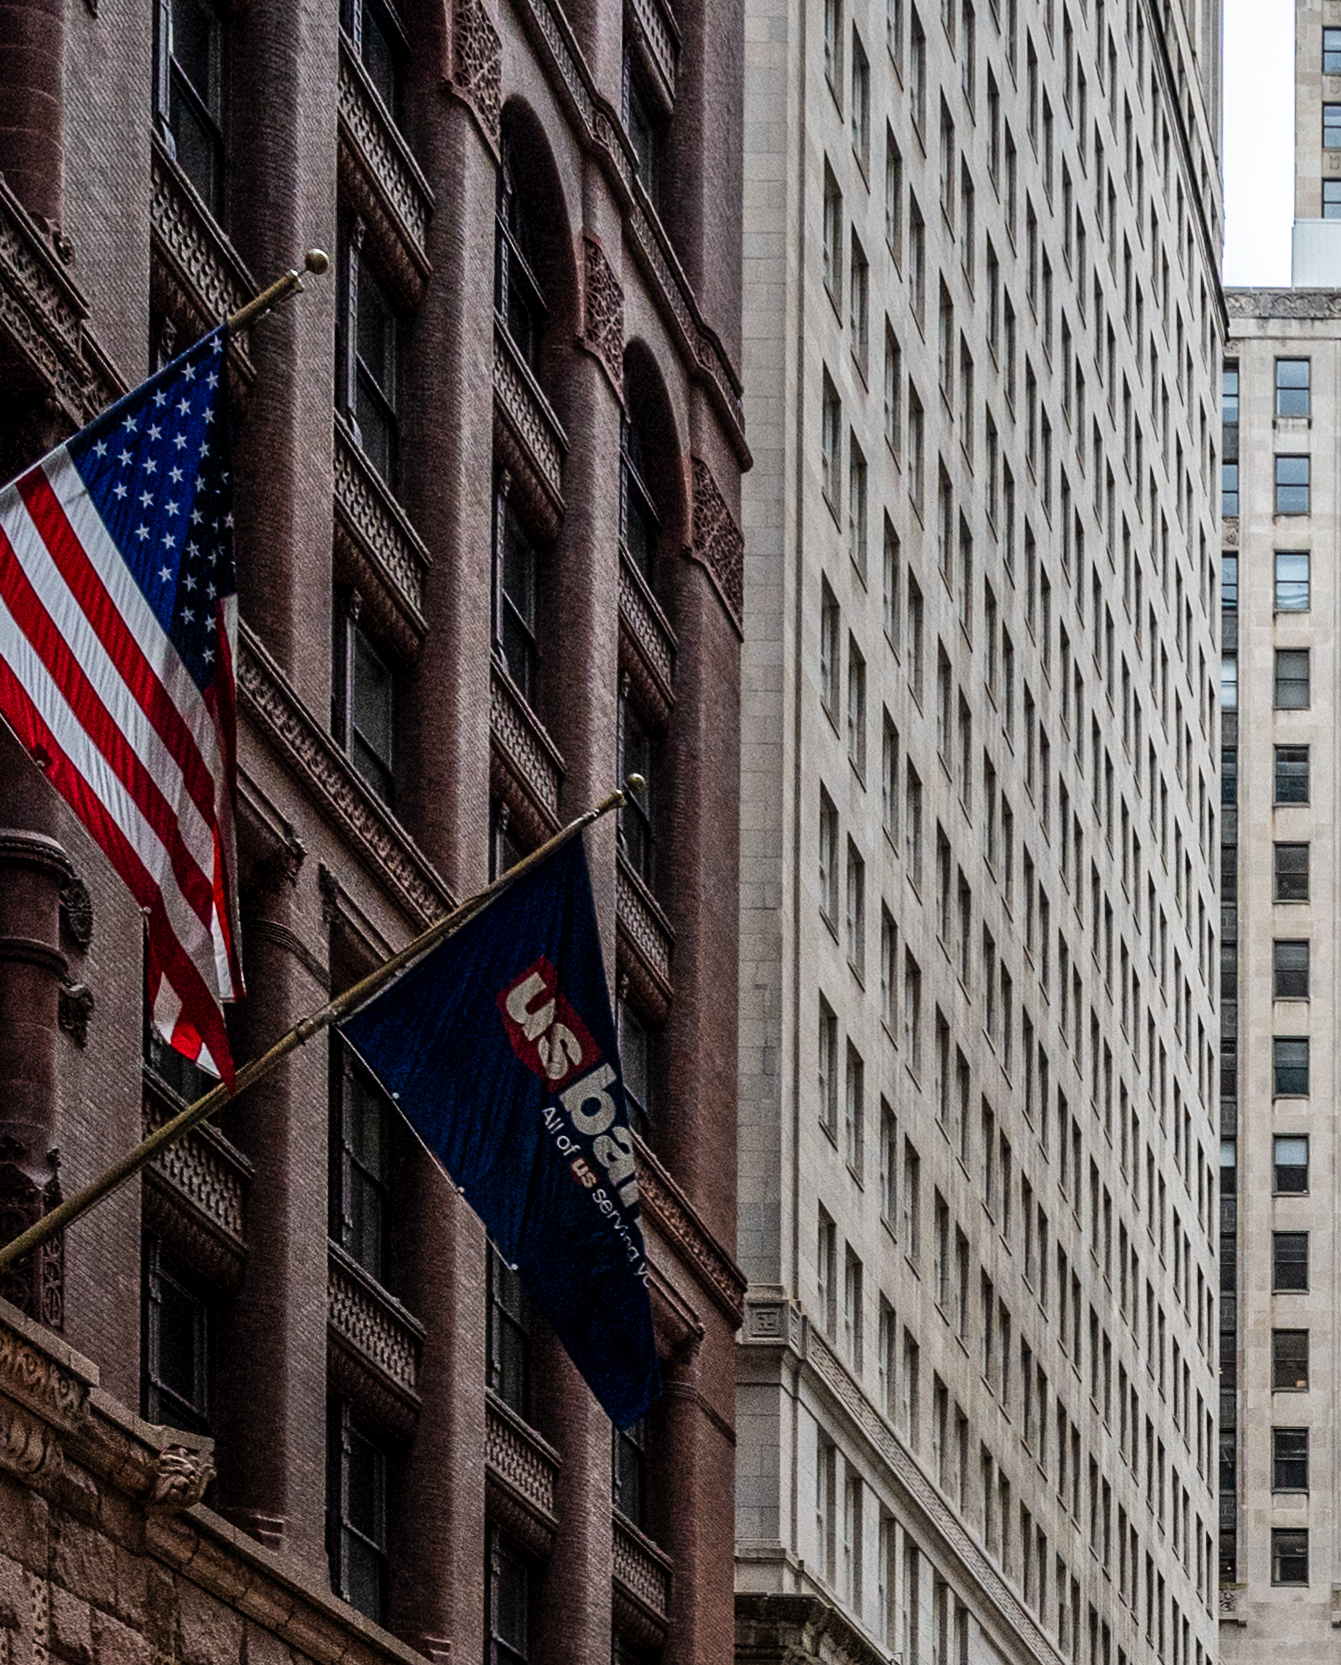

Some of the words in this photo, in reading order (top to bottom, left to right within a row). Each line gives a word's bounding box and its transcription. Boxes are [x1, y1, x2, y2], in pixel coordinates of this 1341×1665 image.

[542, 1106, 565, 1135] All
[556, 1135, 581, 1157] of
[570, 1157, 598, 1189] us
